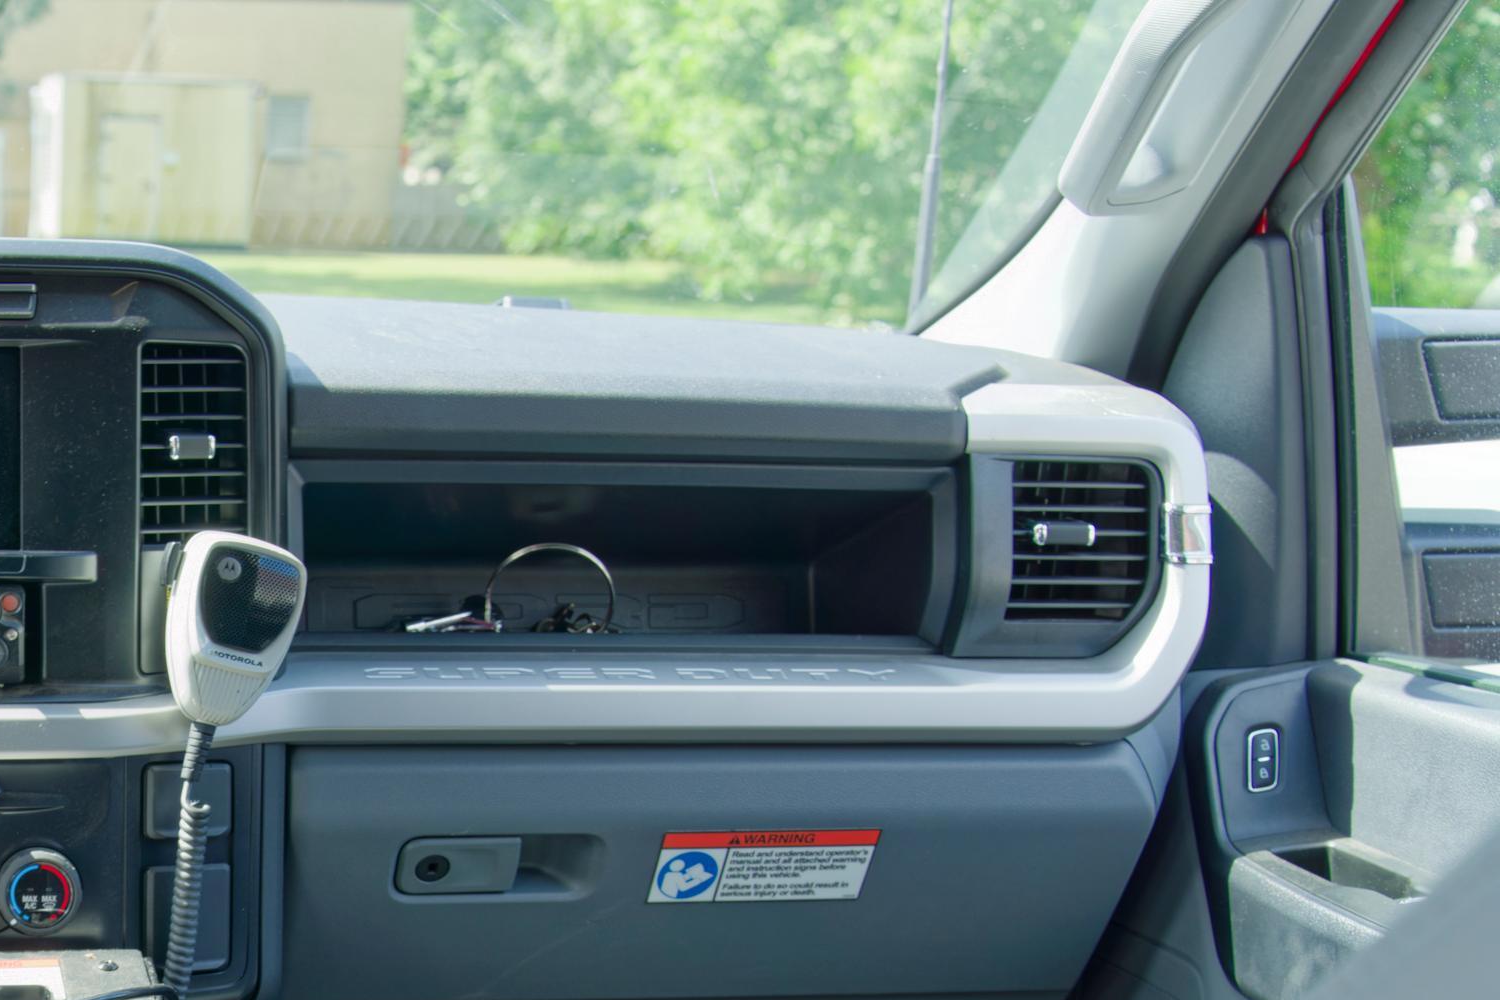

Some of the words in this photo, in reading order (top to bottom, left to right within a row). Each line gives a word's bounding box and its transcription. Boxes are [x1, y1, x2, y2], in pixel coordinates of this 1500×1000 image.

[364, 666, 657, 681] SUPER
[674, 666, 897, 681] DUTY
[743, 833, 816, 845] WARNING
[731, 850, 755, 858] Read
[756, 850, 775, 858] and
[775, 849, 823, 857] understand
[825, 848, 869, 858] operator's
[729, 857, 762, 865] manual
[764, 856, 783, 864] and
[784, 856, 795, 864] all
[795, 855, 831, 864] attached
[832, 856, 867, 866] warning
[727, 864, 746, 872] and
[747, 864, 794, 872] instruction
[794, 864, 818, 874] signs
[818, 863, 847, 871] before
[725, 872, 750, 880] using
[751, 871, 768, 879] this
[769, 871, 801, 879] vehicle.
[721, 882, 752, 890] Failure
[754, 882, 764, 890] to
[764, 881, 776, 889] do
[789, 881, 814, 889] could
[814, 880, 838, 888] result
[839, 880, 849, 888] in
[21, 894, 38, 902] MAX
[41, 894, 58, 902] MAX
[719, 889, 752, 897] serious
[753, 889, 779, 899] injury
[23, 902, 37, 910] A/C
